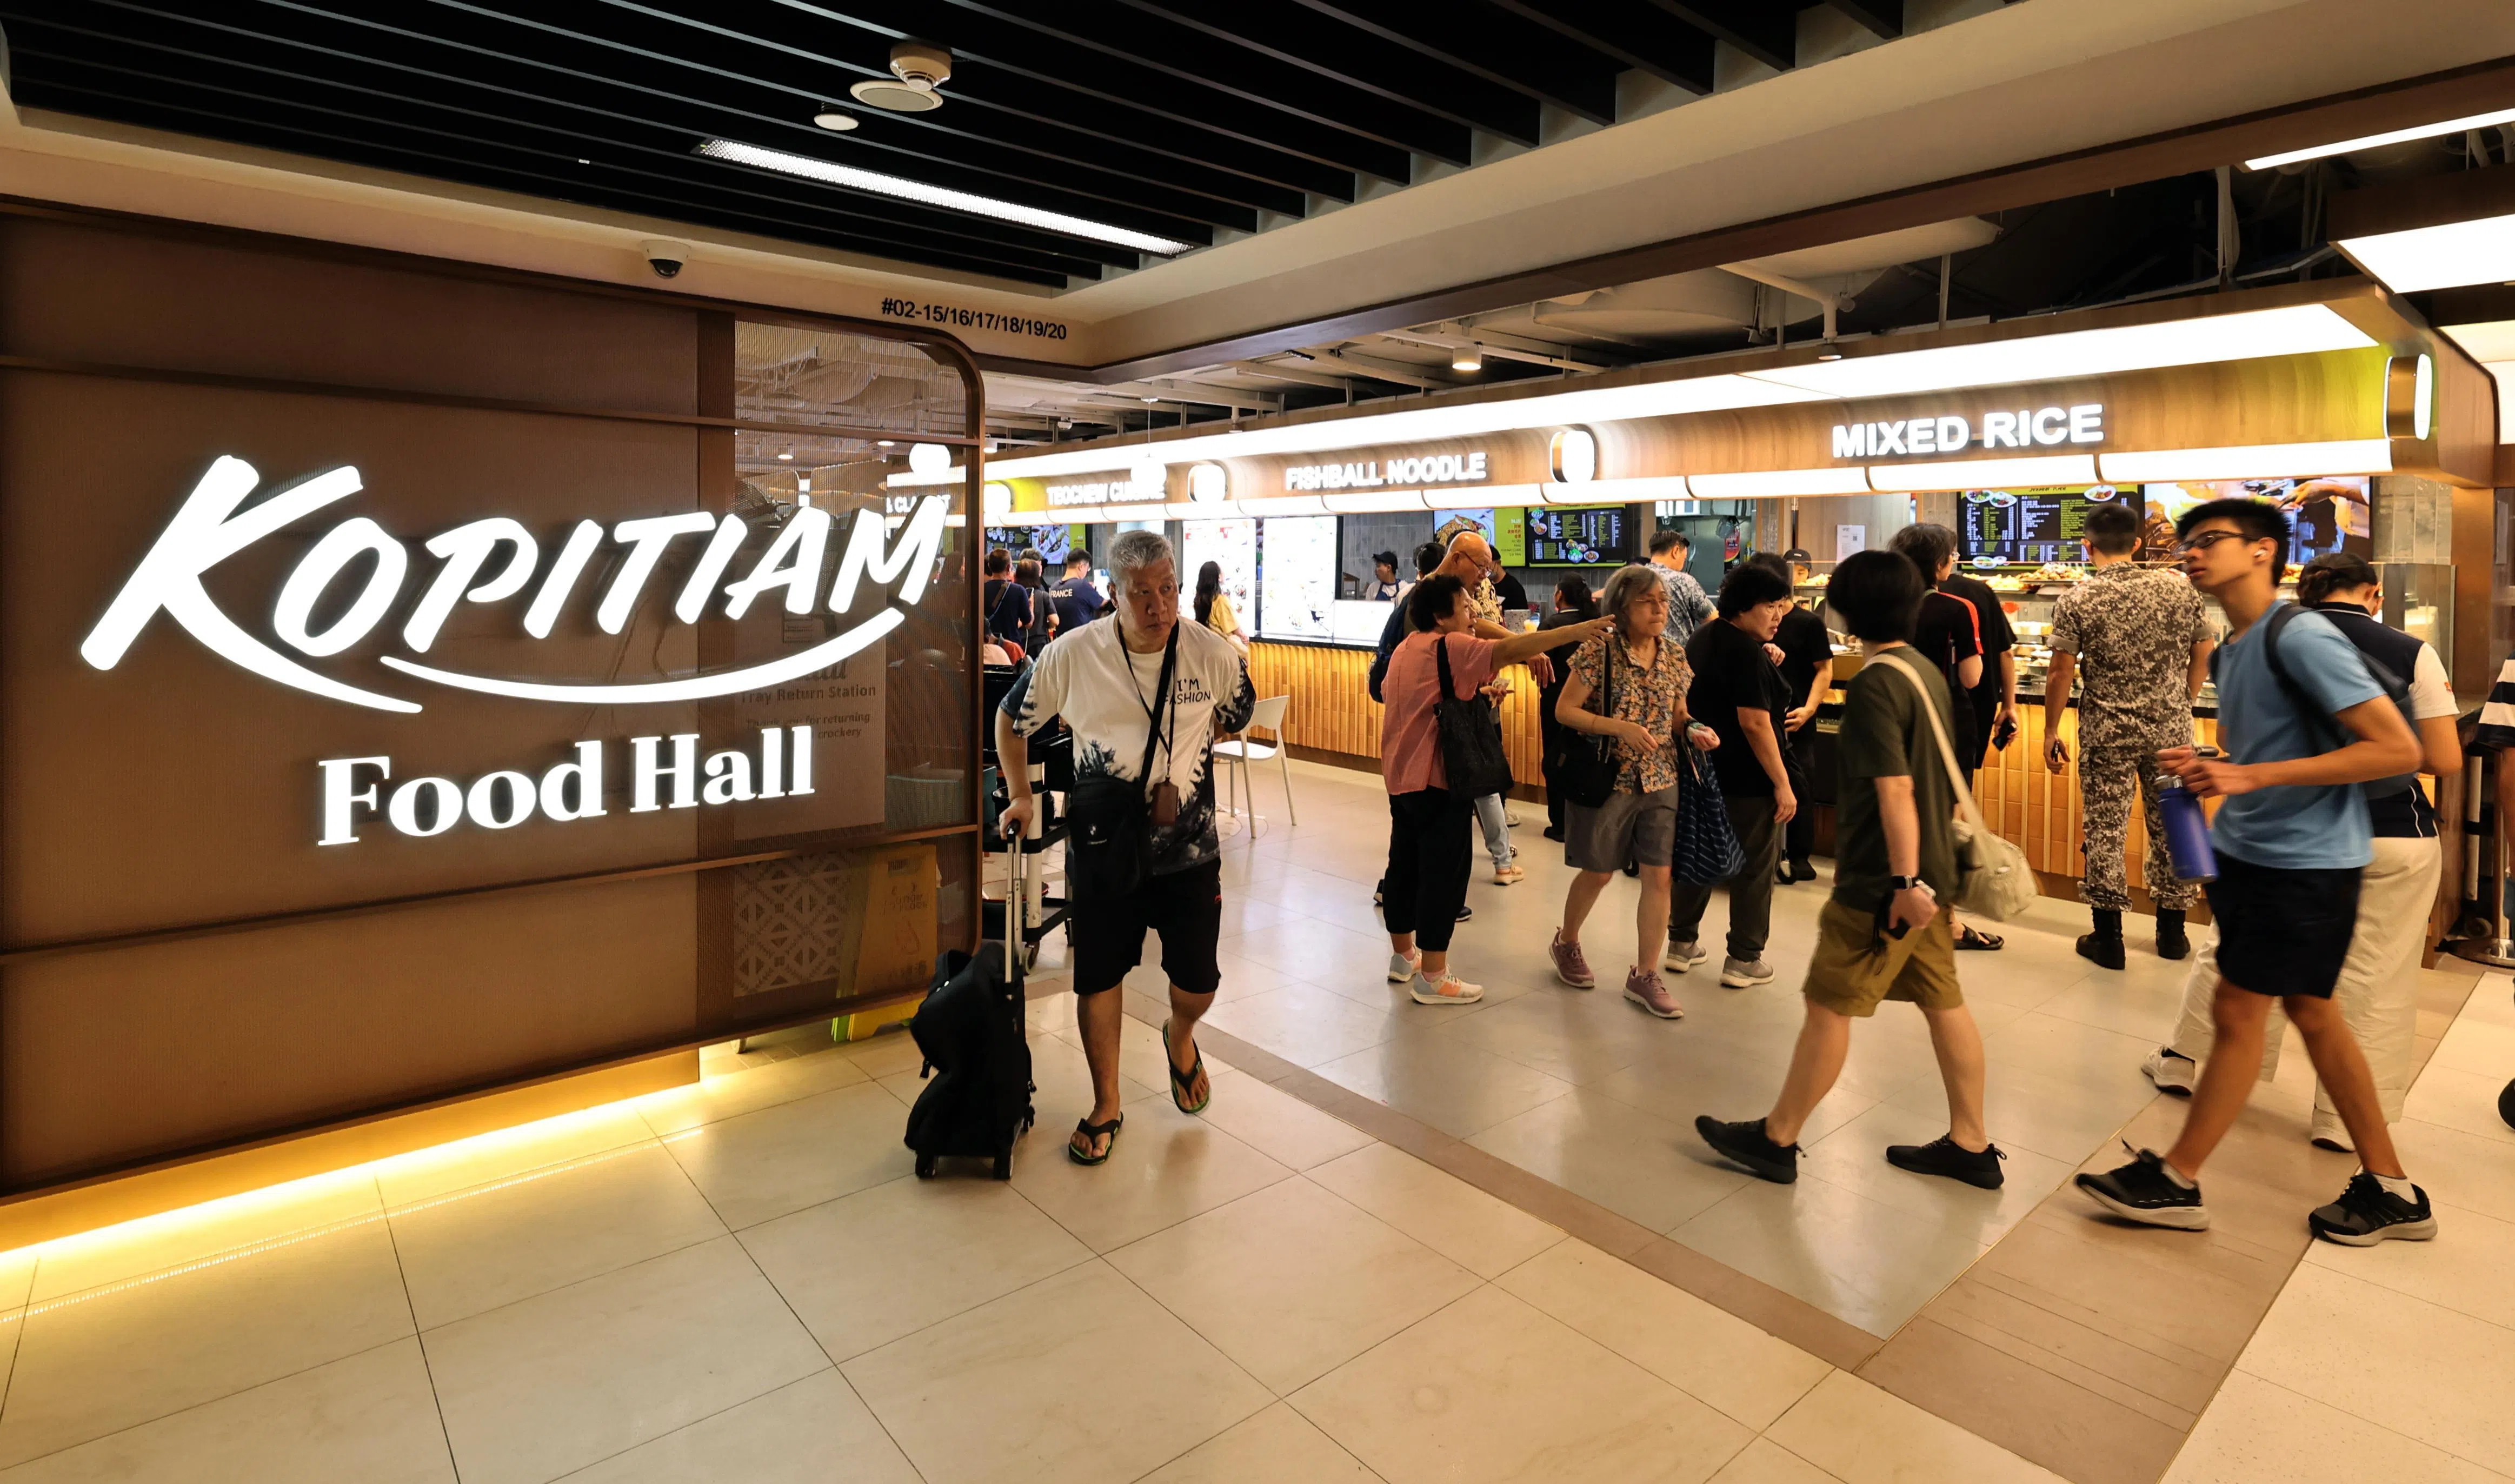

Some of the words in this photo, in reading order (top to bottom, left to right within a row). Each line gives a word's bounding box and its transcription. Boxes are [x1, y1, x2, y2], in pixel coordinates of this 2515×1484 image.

[881, 297, 1068, 340] #02-15/16/17/18/19/20
[1832, 415, 1970, 458] MIXED
[1983, 404, 2104, 449] RICE
[1285, 460, 1383, 491] FISHBALL
[1387, 452, 1487, 485] NOODLE
[81, 455, 947, 713] KOPITIAM
[1050, 589, 1073, 598] FRANCE
[741, 693, 771, 705] Tray
[777, 688, 824, 701] Return
[828, 684, 876, 698] Station
[1177, 678, 1200, 692] I'M
[318, 740, 608, 846] Food
[630, 725, 815, 813] Hall
